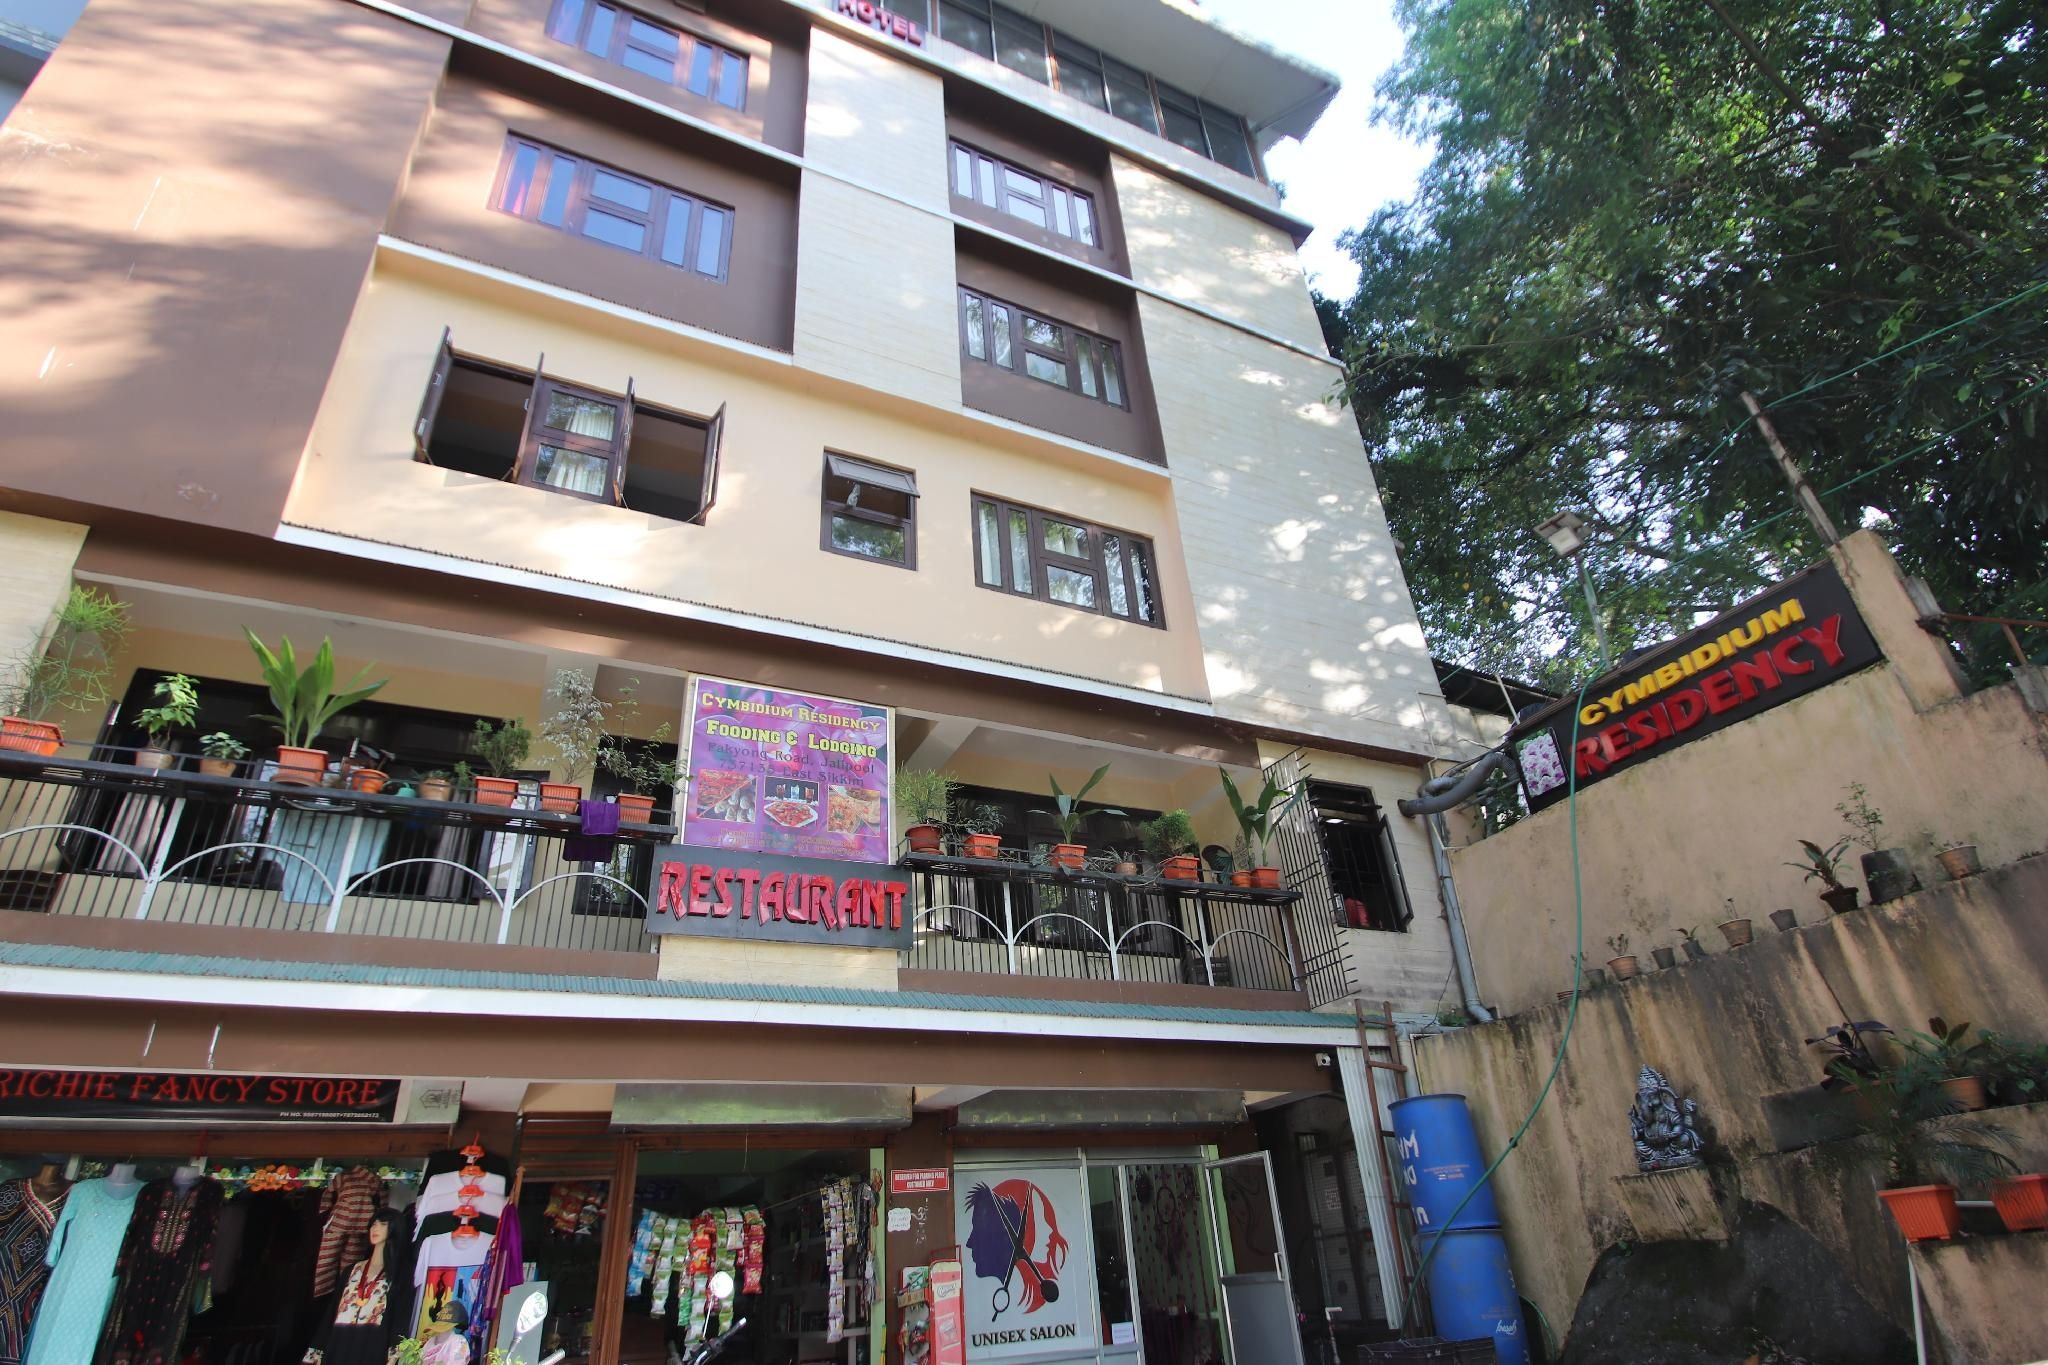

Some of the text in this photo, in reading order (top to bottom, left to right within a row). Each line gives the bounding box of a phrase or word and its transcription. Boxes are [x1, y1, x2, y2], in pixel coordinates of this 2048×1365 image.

[838, 0, 922, 47] HOTEL
[1579, 598, 1806, 727] CYMBIDIUM
[1572, 613, 1846, 780] RESIDENCY
[783, 766, 812, 780] East
[818, 771, 864, 787] Sikkim
[656, 861, 908, 932] RESTAURANT
[0, 1070, 382, 1106] RICHIE FANCY STORE
[972, 1323, 1077, 1347] UNISEX SALON
